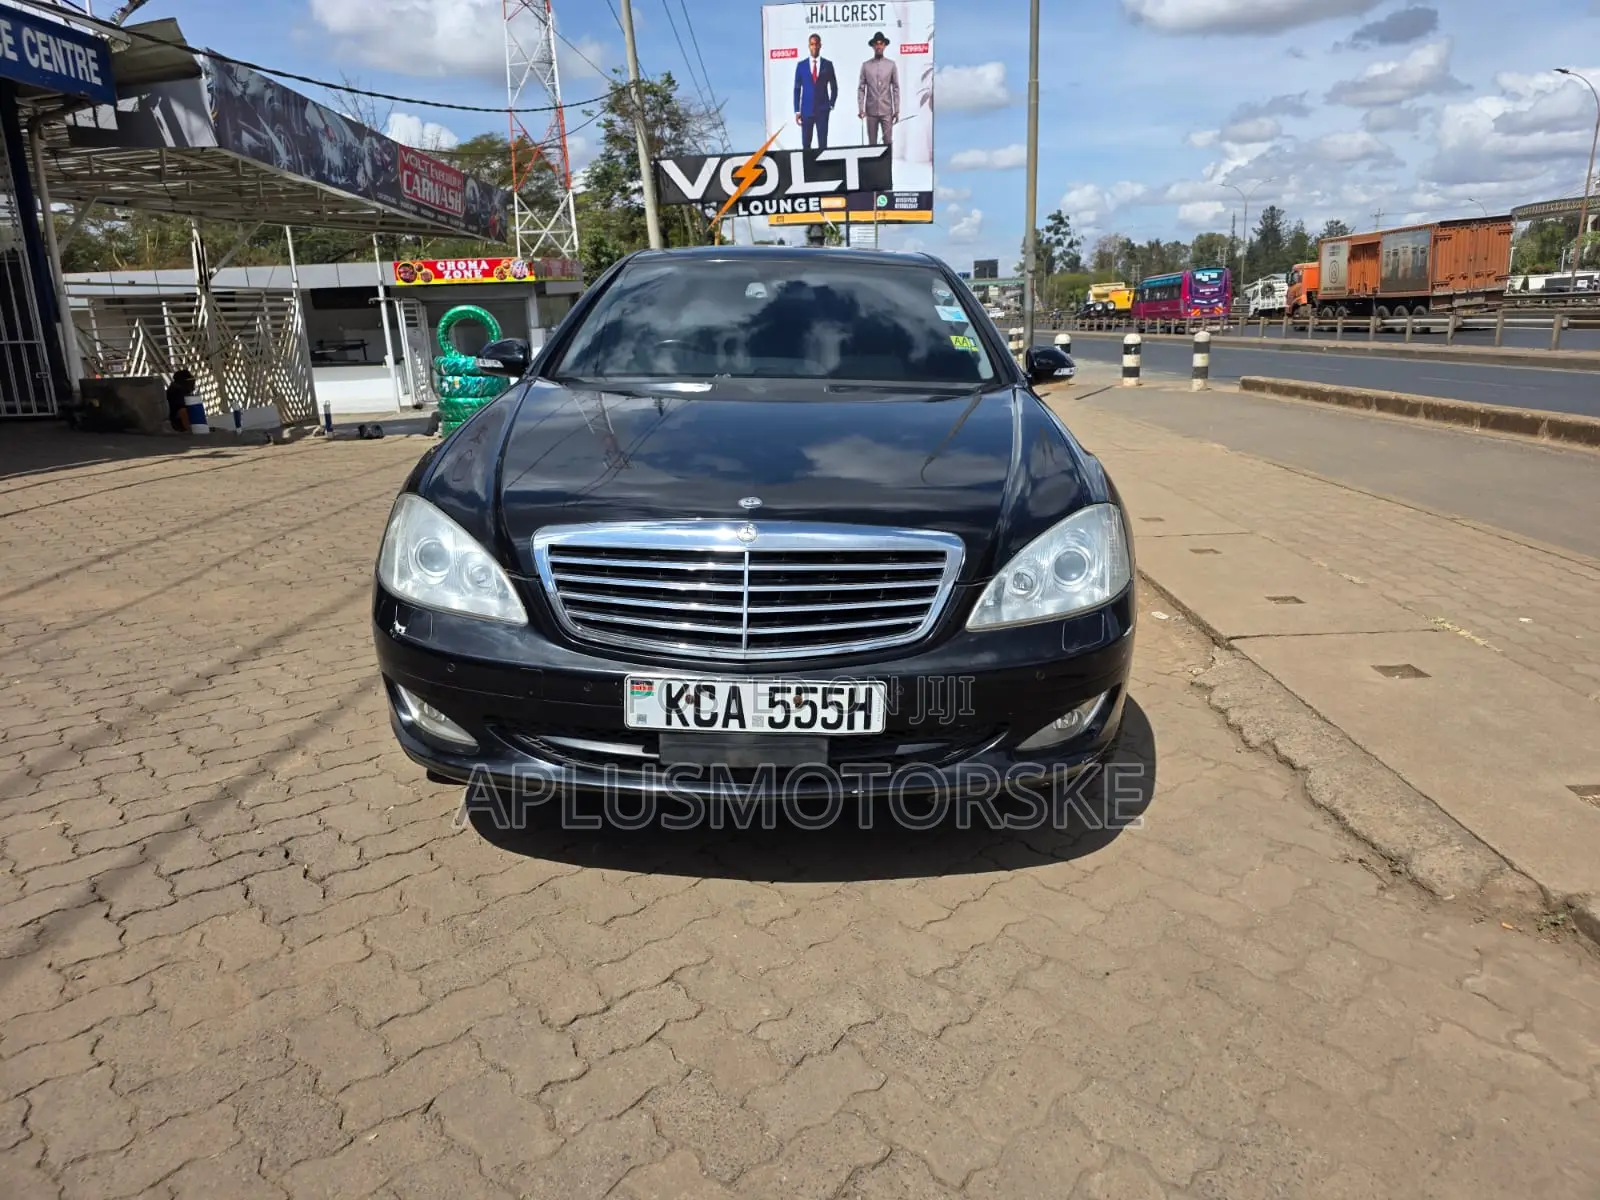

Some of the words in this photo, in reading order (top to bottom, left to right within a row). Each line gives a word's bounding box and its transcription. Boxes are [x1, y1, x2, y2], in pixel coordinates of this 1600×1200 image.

[810, 4, 886, 23] HILLCREST
[0, 19, 18, 61] E
[22, 27, 103, 86] CENTRE
[401, 150, 431, 173] VOLT
[659, 146, 889, 200] VOLT
[402, 169, 464, 214] CARWASH
[737, 197, 820, 216] LOUNGE
[436, 260, 490, 270] CHOMA
[443, 269, 483, 279] ZONE
[665, 682, 747, 729] KCA
[767, 686, 873, 731] 555H
